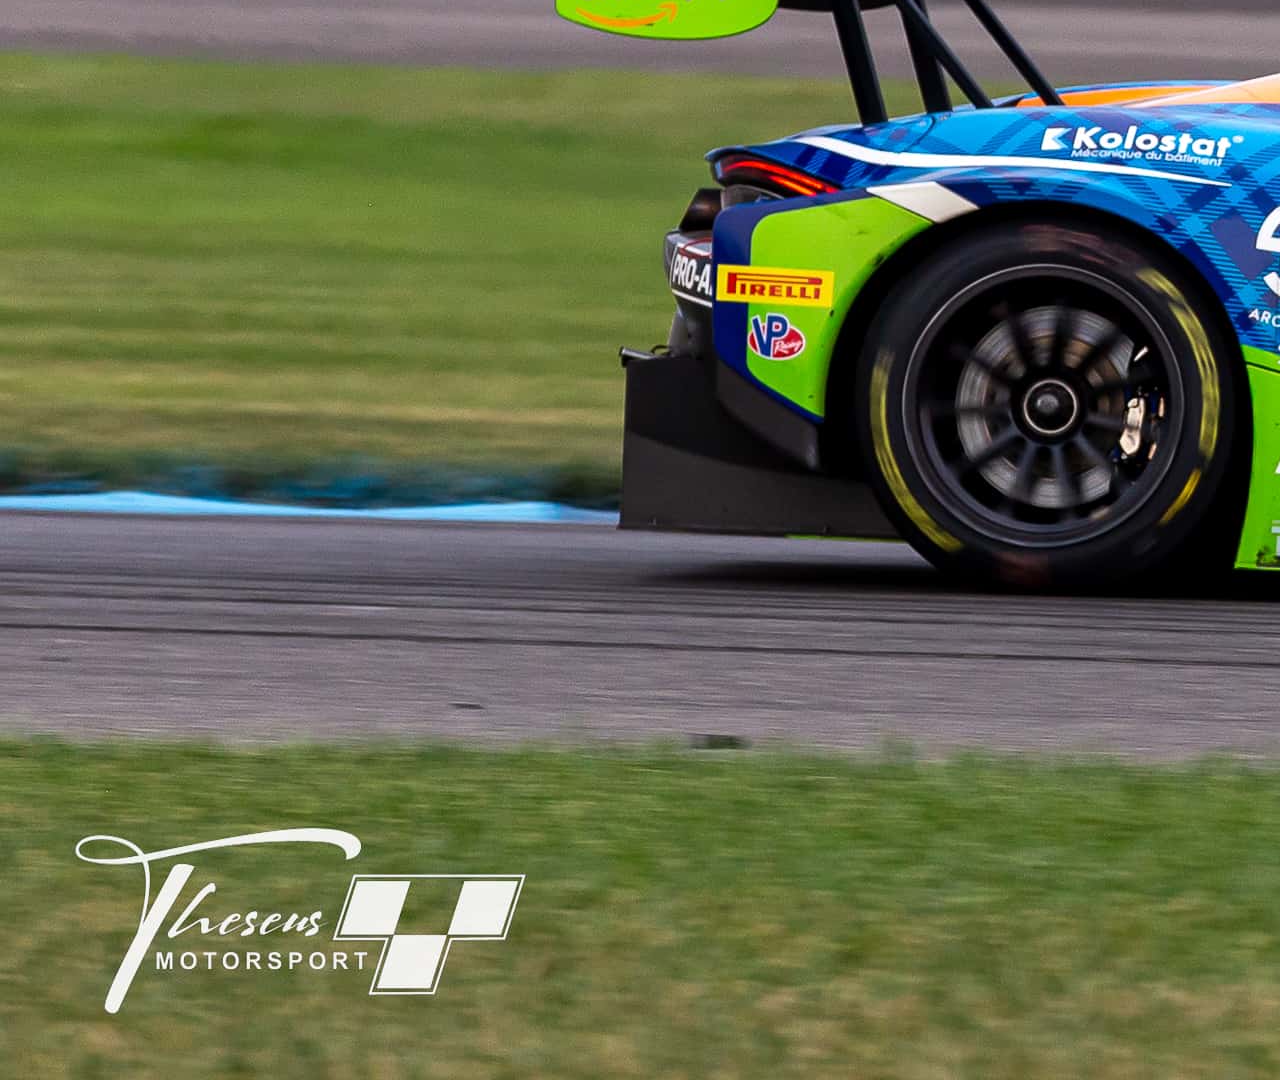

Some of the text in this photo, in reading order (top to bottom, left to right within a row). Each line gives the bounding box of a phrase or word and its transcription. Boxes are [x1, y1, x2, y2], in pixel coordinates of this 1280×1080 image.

[1073, 125, 1231, 158] Kolostat
[1145, 151, 1163, 161] du
[672, 254, 713, 296] PRO-A
[726, 271, 824, 300] PIRELLI
[751, 314, 789, 358] VP
